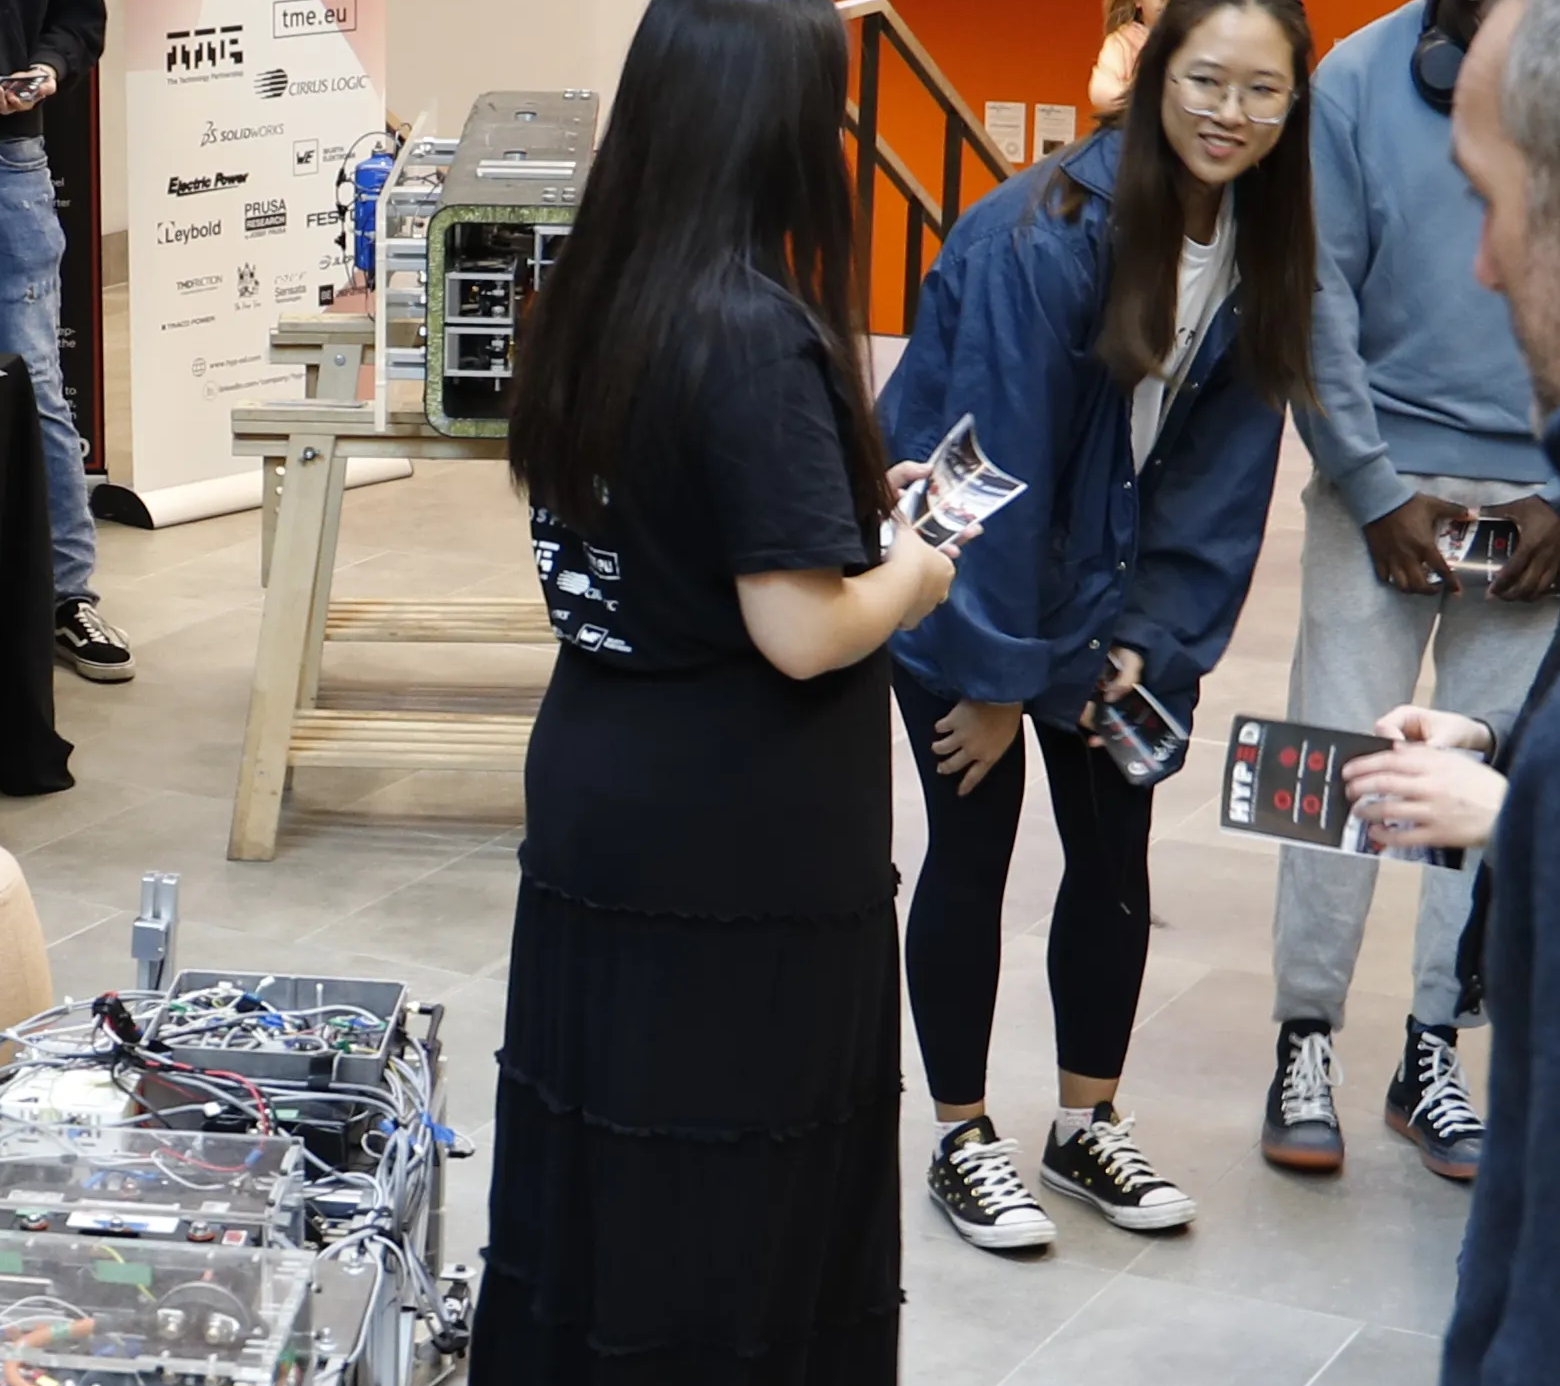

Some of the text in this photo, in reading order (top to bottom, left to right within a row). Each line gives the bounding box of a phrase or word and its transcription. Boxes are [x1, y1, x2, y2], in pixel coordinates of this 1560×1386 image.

[282, 5, 347, 28] tme.eu
[288, 75, 370, 96] CIRRUS LOGIC
[219, 123, 284, 142] SOLIDWORKS
[167, 172, 249, 196] Electric Power
[244, 199, 287, 216] PRUSA
[165, 220, 221, 245] Leybold
[245, 215, 287, 231] RESEARCH
